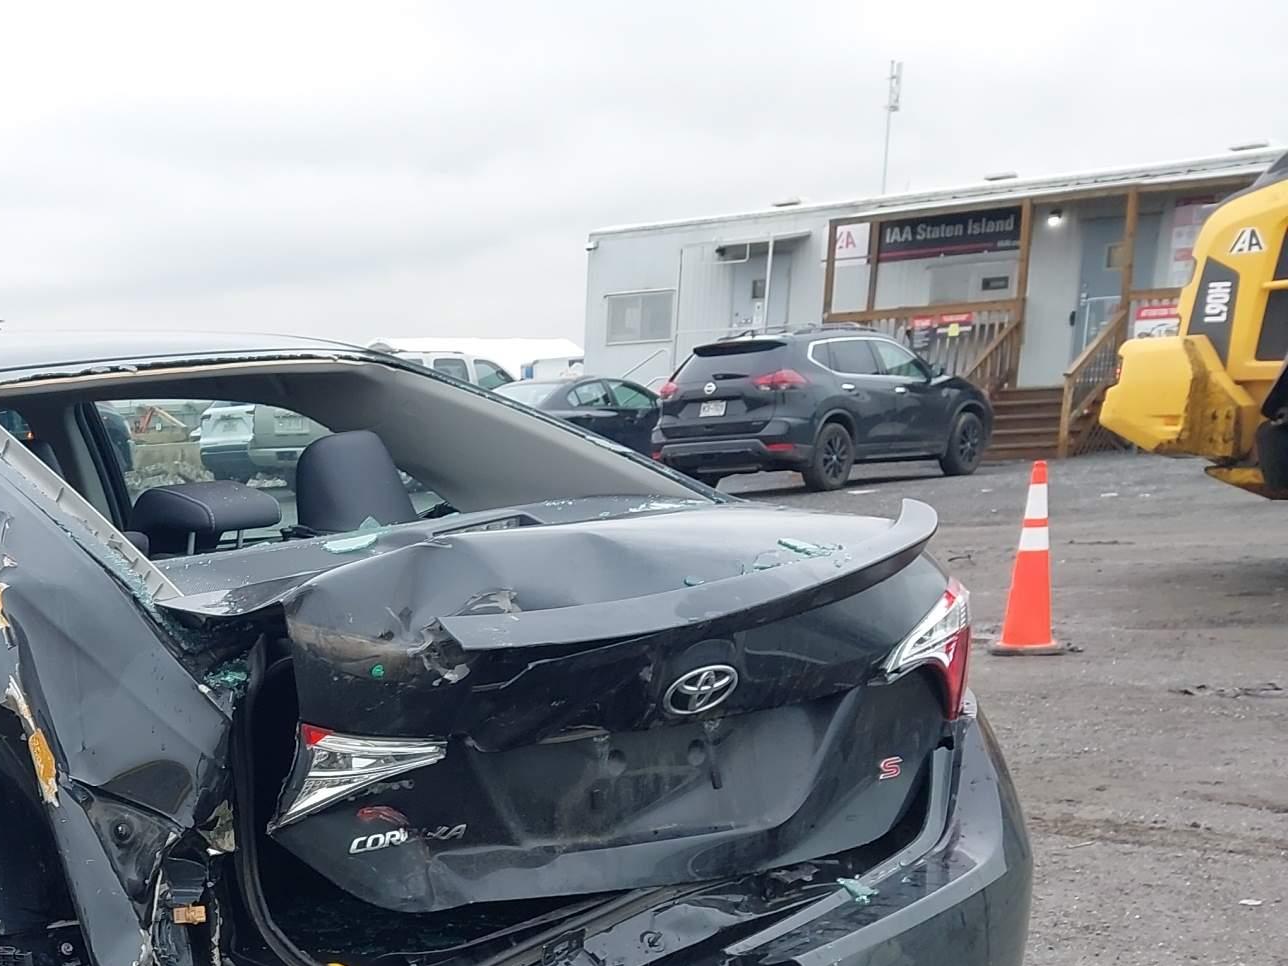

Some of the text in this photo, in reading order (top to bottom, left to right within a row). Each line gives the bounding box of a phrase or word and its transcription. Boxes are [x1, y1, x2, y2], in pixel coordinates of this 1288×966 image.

[885, 215, 1014, 243] IAA Staten Island
[879, 756, 903, 780] S
